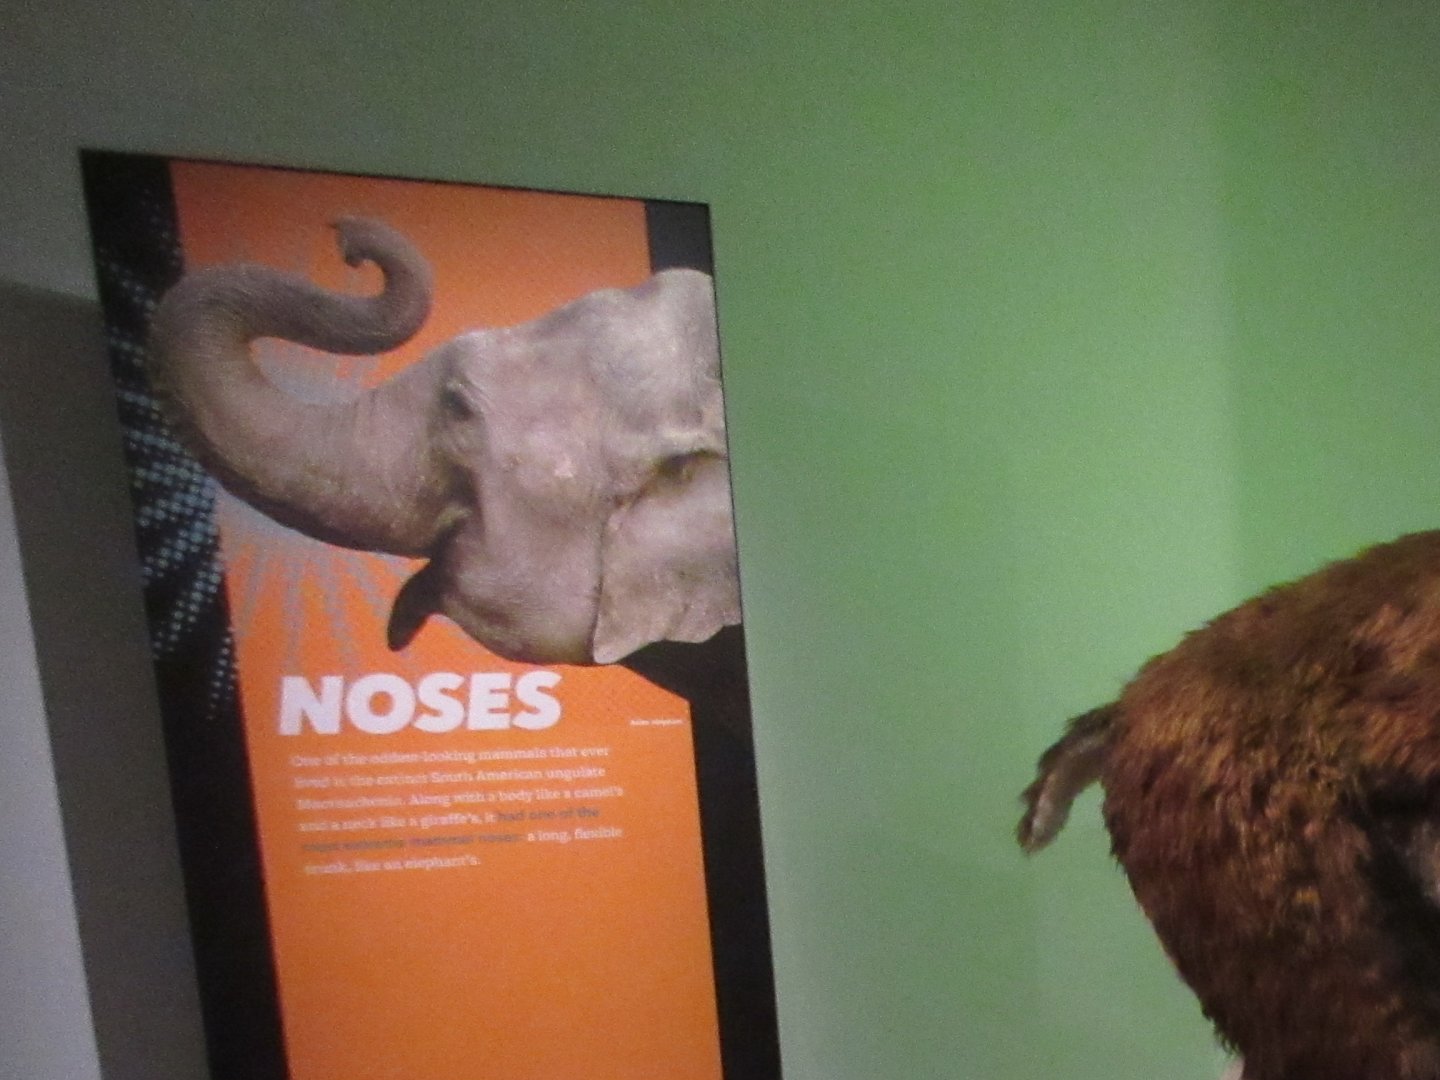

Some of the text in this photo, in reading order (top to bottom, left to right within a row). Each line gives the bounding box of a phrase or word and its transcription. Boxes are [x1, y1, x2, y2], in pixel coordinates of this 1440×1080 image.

[278, 671, 562, 735] NOSES
[342, 752, 367, 765] the
[479, 748, 547, 760] mammals
[549, 746, 577, 758] that
[581, 747, 609, 757] ever
[350, 775, 374, 786] the
[376, 774, 428, 785] extinct
[430, 771, 473, 783] South
[477, 769, 543, 781] American
[546, 767, 606, 782] ungulate
[409, 793, 451, 807] Along
[453, 792, 486, 803] with
[488, 792, 496, 802] a
[498, 789, 533, 803] body
[535, 788, 560, 800] like
[563, 790, 571, 799] a
[574, 785, 624, 798] camel's
[380, 816, 407, 828] like
[409, 817, 419, 827] a
[576, 806, 599, 818] the
[527, 832, 536, 842] a
[538, 830, 572, 844] long,
[575, 828, 624, 840] flexible
